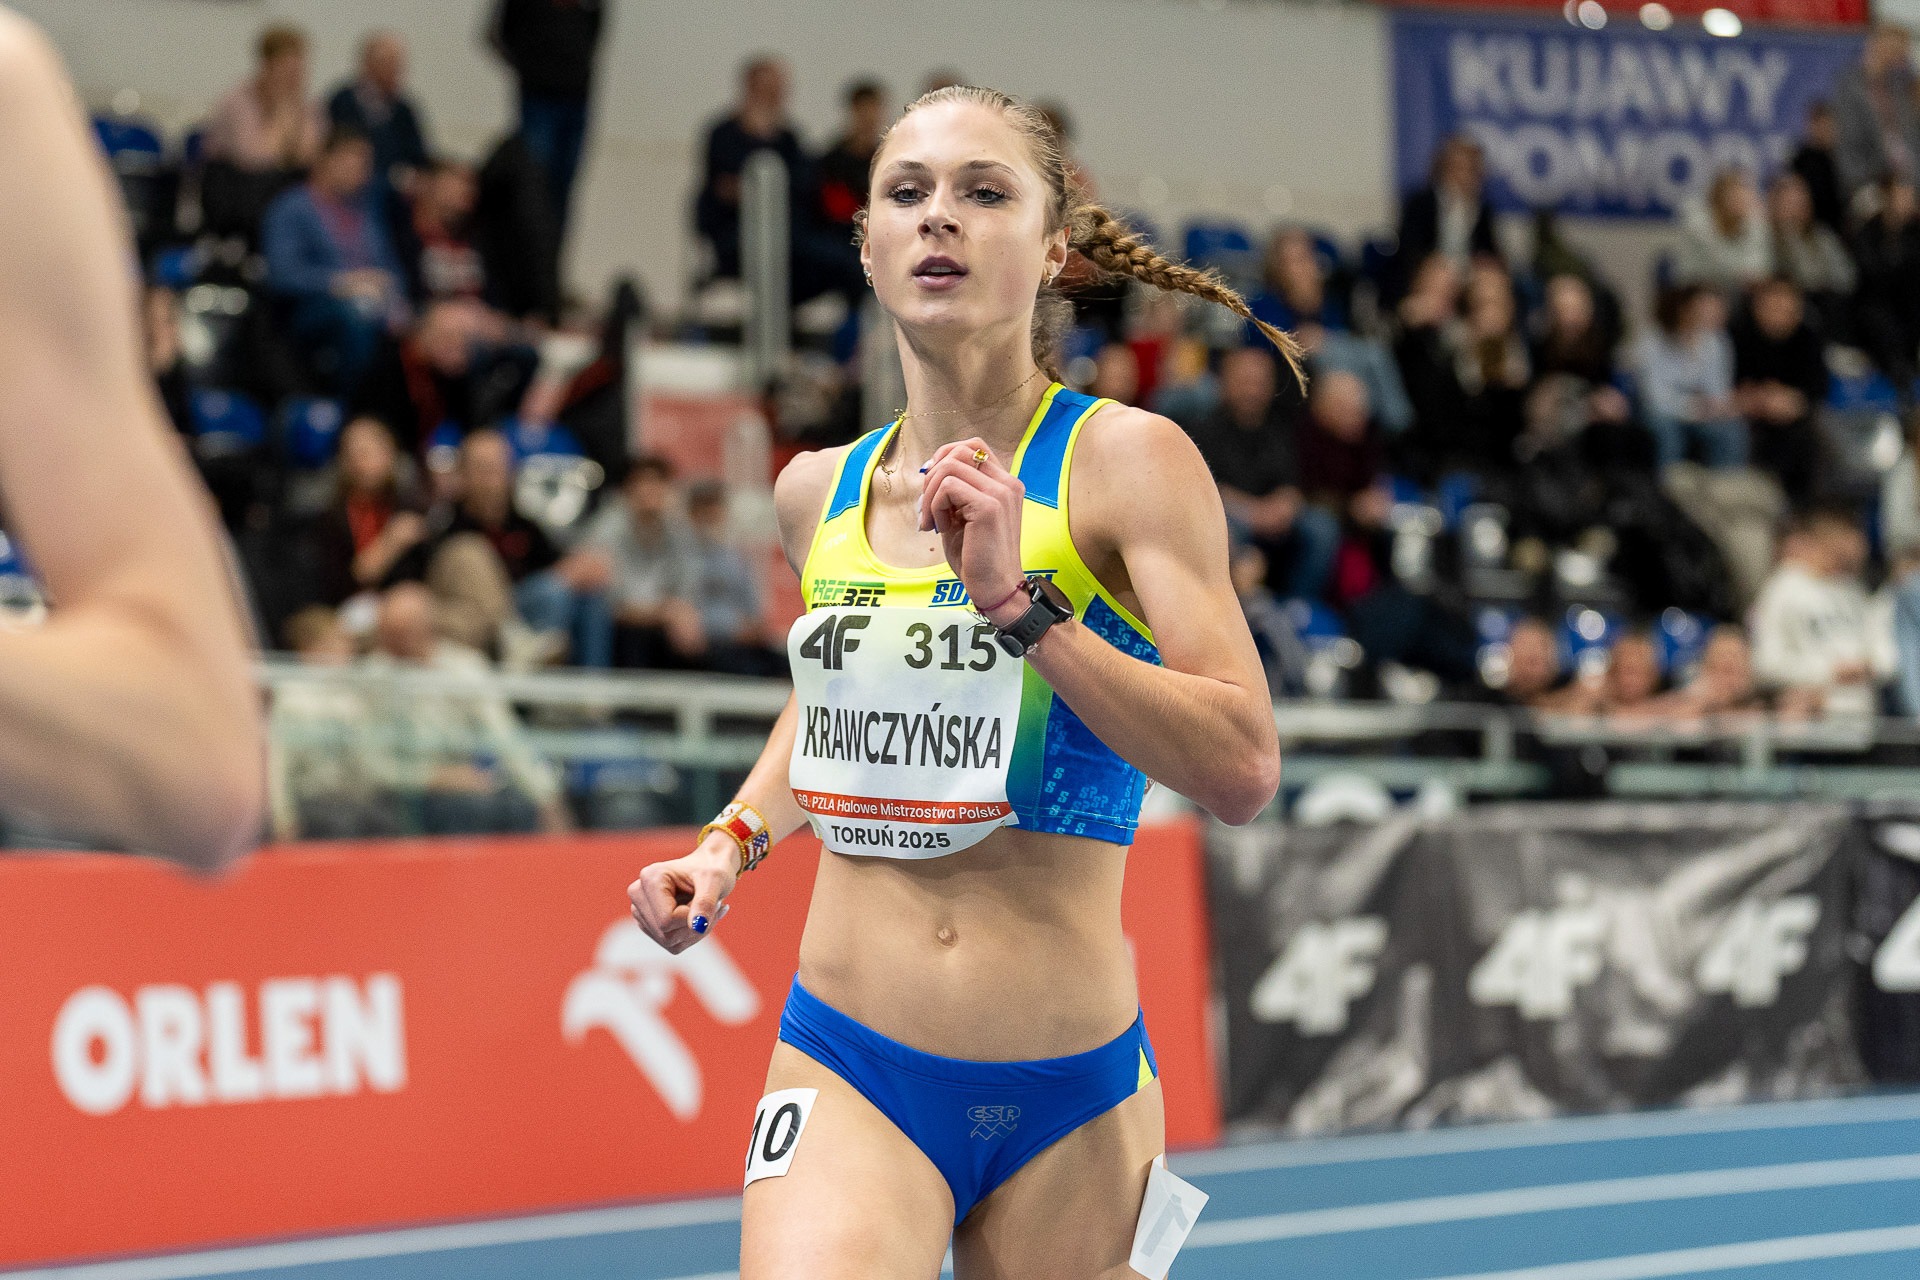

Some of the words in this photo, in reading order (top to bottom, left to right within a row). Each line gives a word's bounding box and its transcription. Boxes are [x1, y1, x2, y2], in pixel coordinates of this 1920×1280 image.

[1447, 33, 1790, 123] KUJAWY
[800, 614, 871, 670] 4F
[904, 622, 997, 671] 315
[802, 702, 1001, 769] KRAWCZYŃSKA
[811, 796, 835, 811] PZLA
[836, 799, 878, 815] Halowe
[880, 802, 956, 819] Mistrzostwa
[958, 805, 1002, 819] Polski
[830, 823, 895, 847] TORUŃ
[897, 830, 951, 849] 2025
[51, 972, 406, 1116] ORLEN
[746, 1102, 802, 1172] 10
